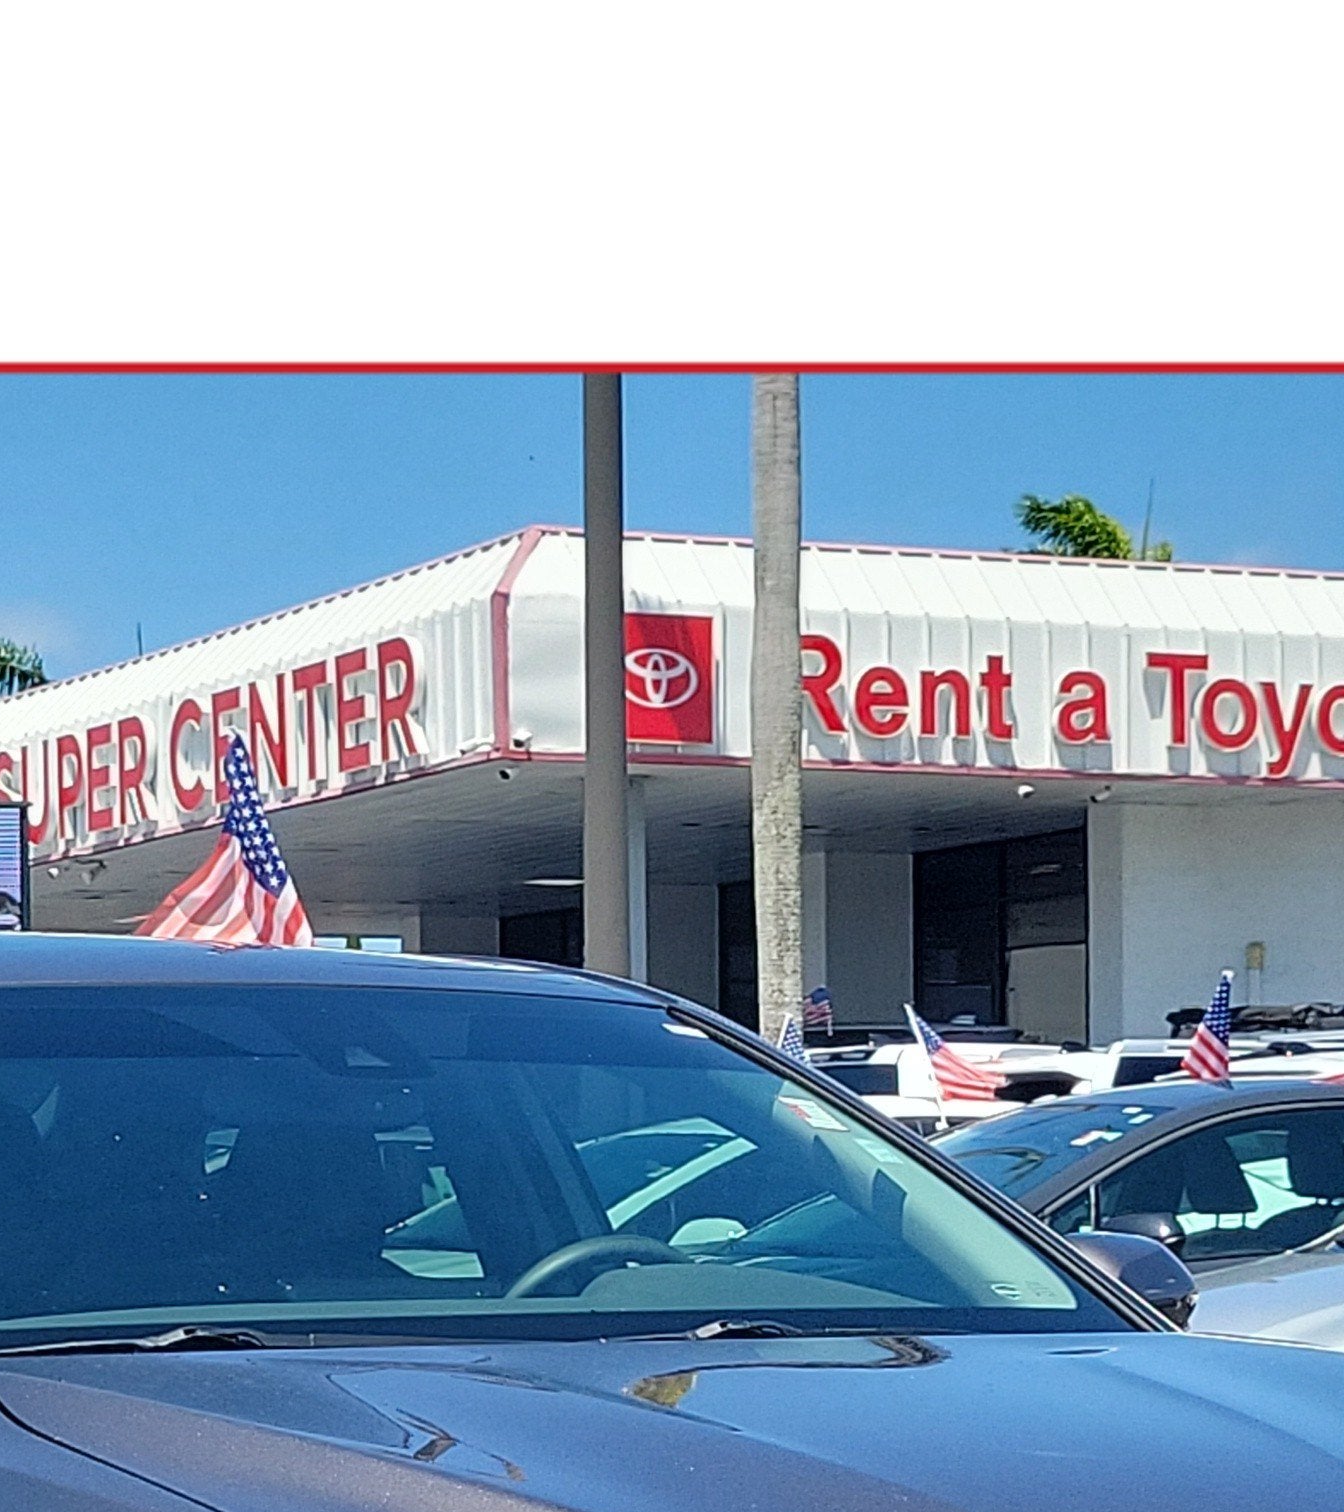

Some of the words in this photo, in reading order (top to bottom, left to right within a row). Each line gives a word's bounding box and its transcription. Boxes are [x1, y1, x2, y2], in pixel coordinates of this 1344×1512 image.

[169, 636, 419, 812] CENTER
[800, 633, 1013, 740] Rent
[1056, 670, 1112, 742] a
